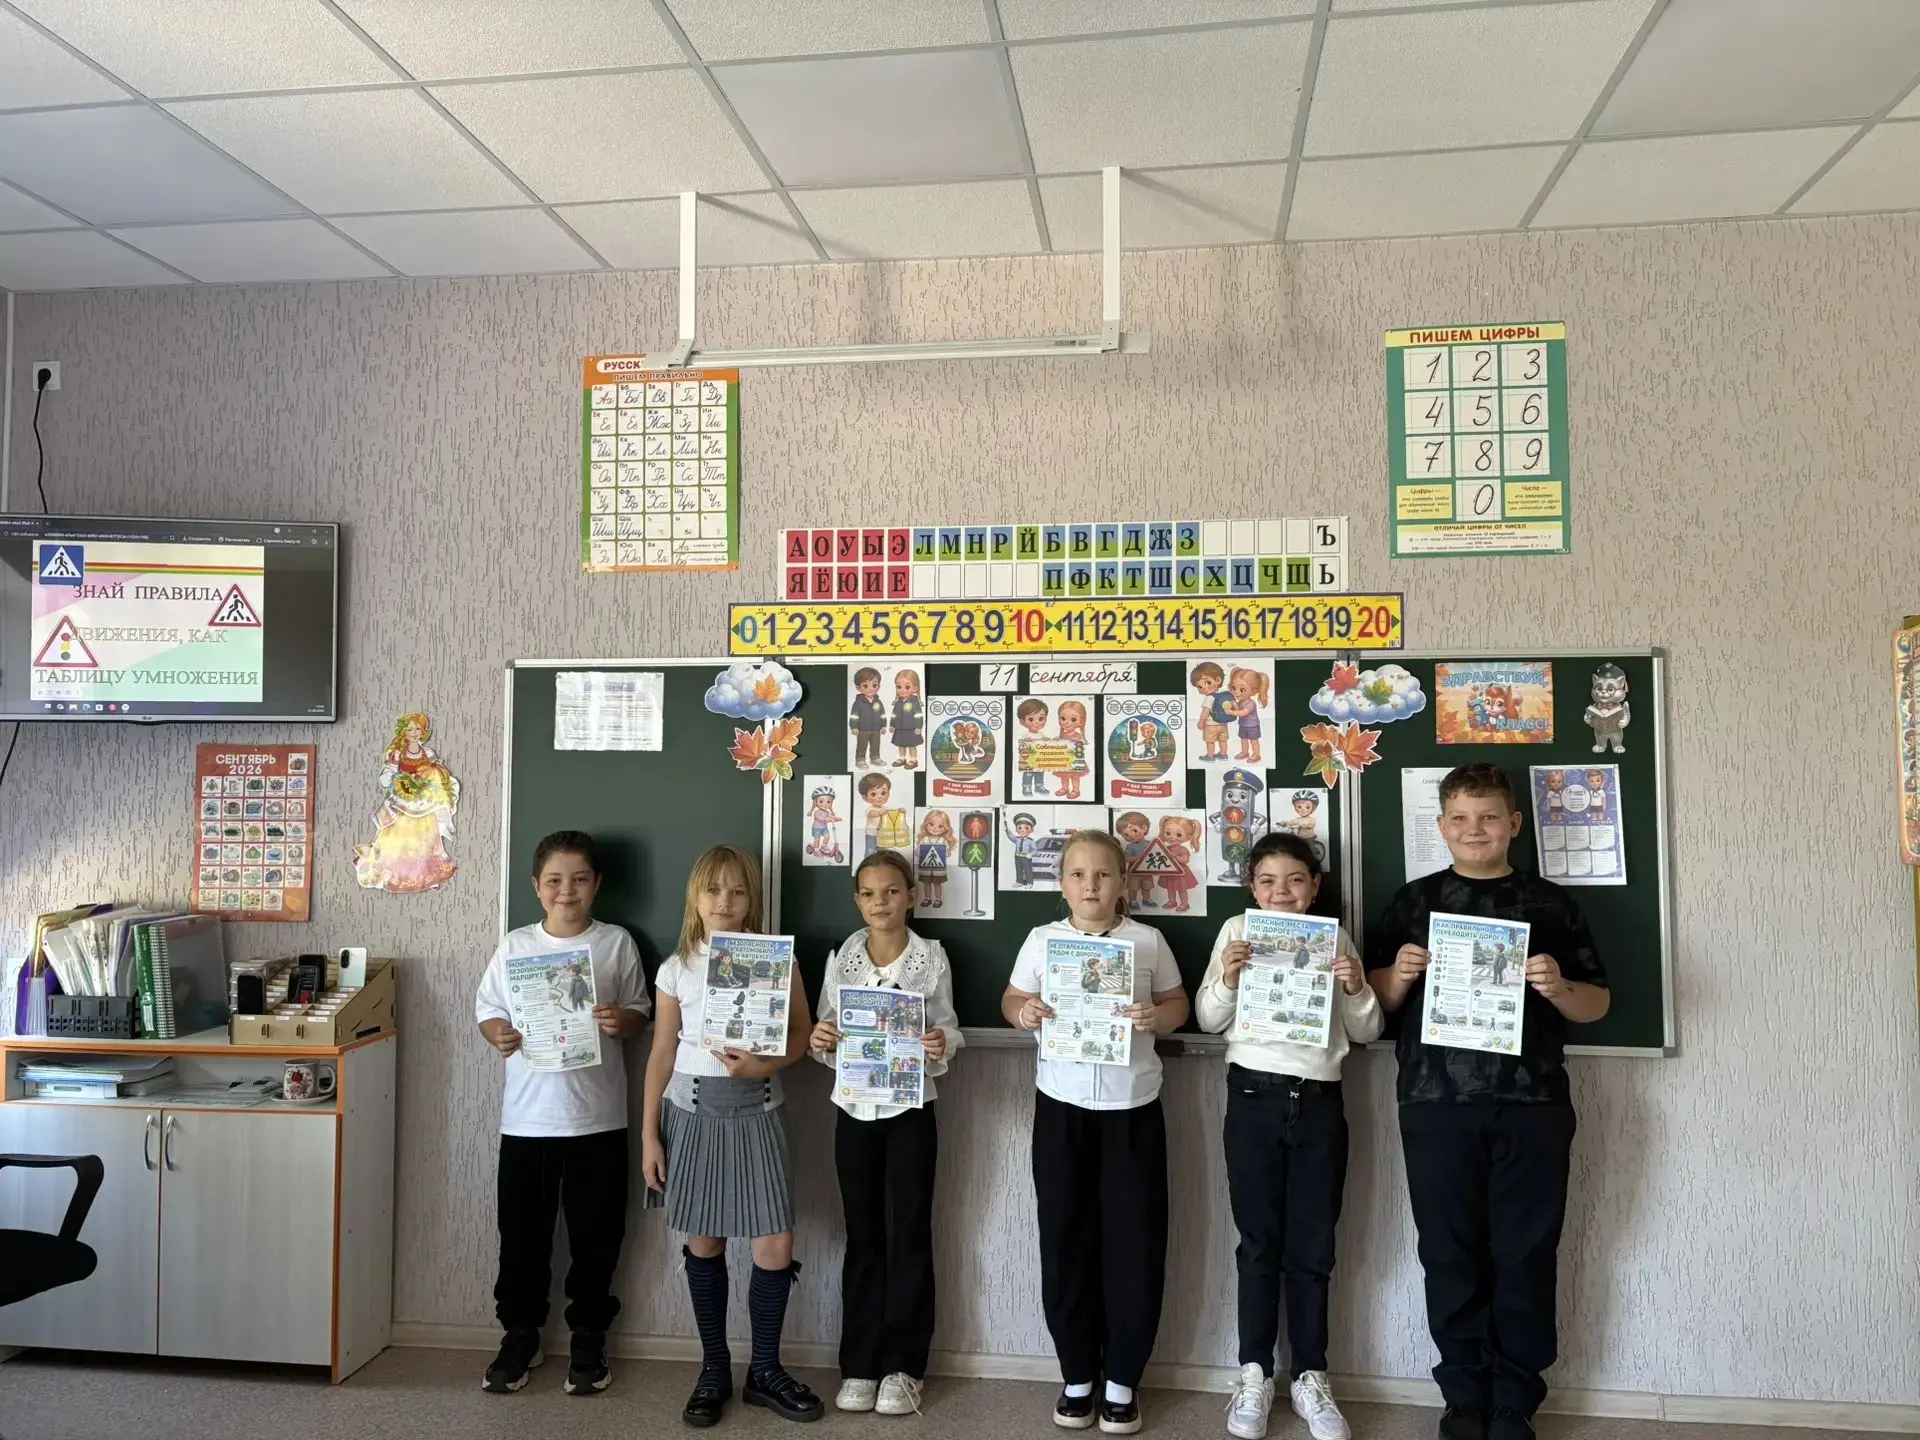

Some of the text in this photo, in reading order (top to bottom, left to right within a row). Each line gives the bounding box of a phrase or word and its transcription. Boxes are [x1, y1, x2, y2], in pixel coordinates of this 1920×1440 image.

[1410, 326, 1540, 344] ПИШЕМ ЦИФРЫ
[604, 360, 641, 371] РУССК
[1426, 348, 1541, 383] 1 2 3
[613, 372, 704, 381] ПИШЕМ ПРАВИЛЬНО
[1425, 393, 1542, 428] 4 5 6
[1424, 438, 1543, 472] 7 8 9
[1473, 483, 1494, 516] 0
[789, 526, 1336, 557] А О У Ы Э Л М Н Р Й Б В Г Д Ж З Ъ
[789, 564, 1335, 593] Я Ё Ю И Е П Ф К Т Ш С Х Ц Ч Щ Ь
[72, 582, 223, 600] ЗНАЙ ПРАВИЛА
[740, 606, 1391, 645] 0 1 2 3 4 5 6 7 8 9 10 11 12 13 14 15 16 17 18 19 20
[188, 629, 228, 643] КАК
[36, 669, 258, 686] ТАБЛИЦУ УМНОЖЕНИЯ
[990, 666, 1016, 686] 11
[1444, 670, 1548, 688] ЗДРАВСТВУЙ,
[1496, 718, 1548, 730] КЛАСС!
[216, 754, 276, 765] СЕНТЯБРЬ
[229, 765, 262, 775] 2026
